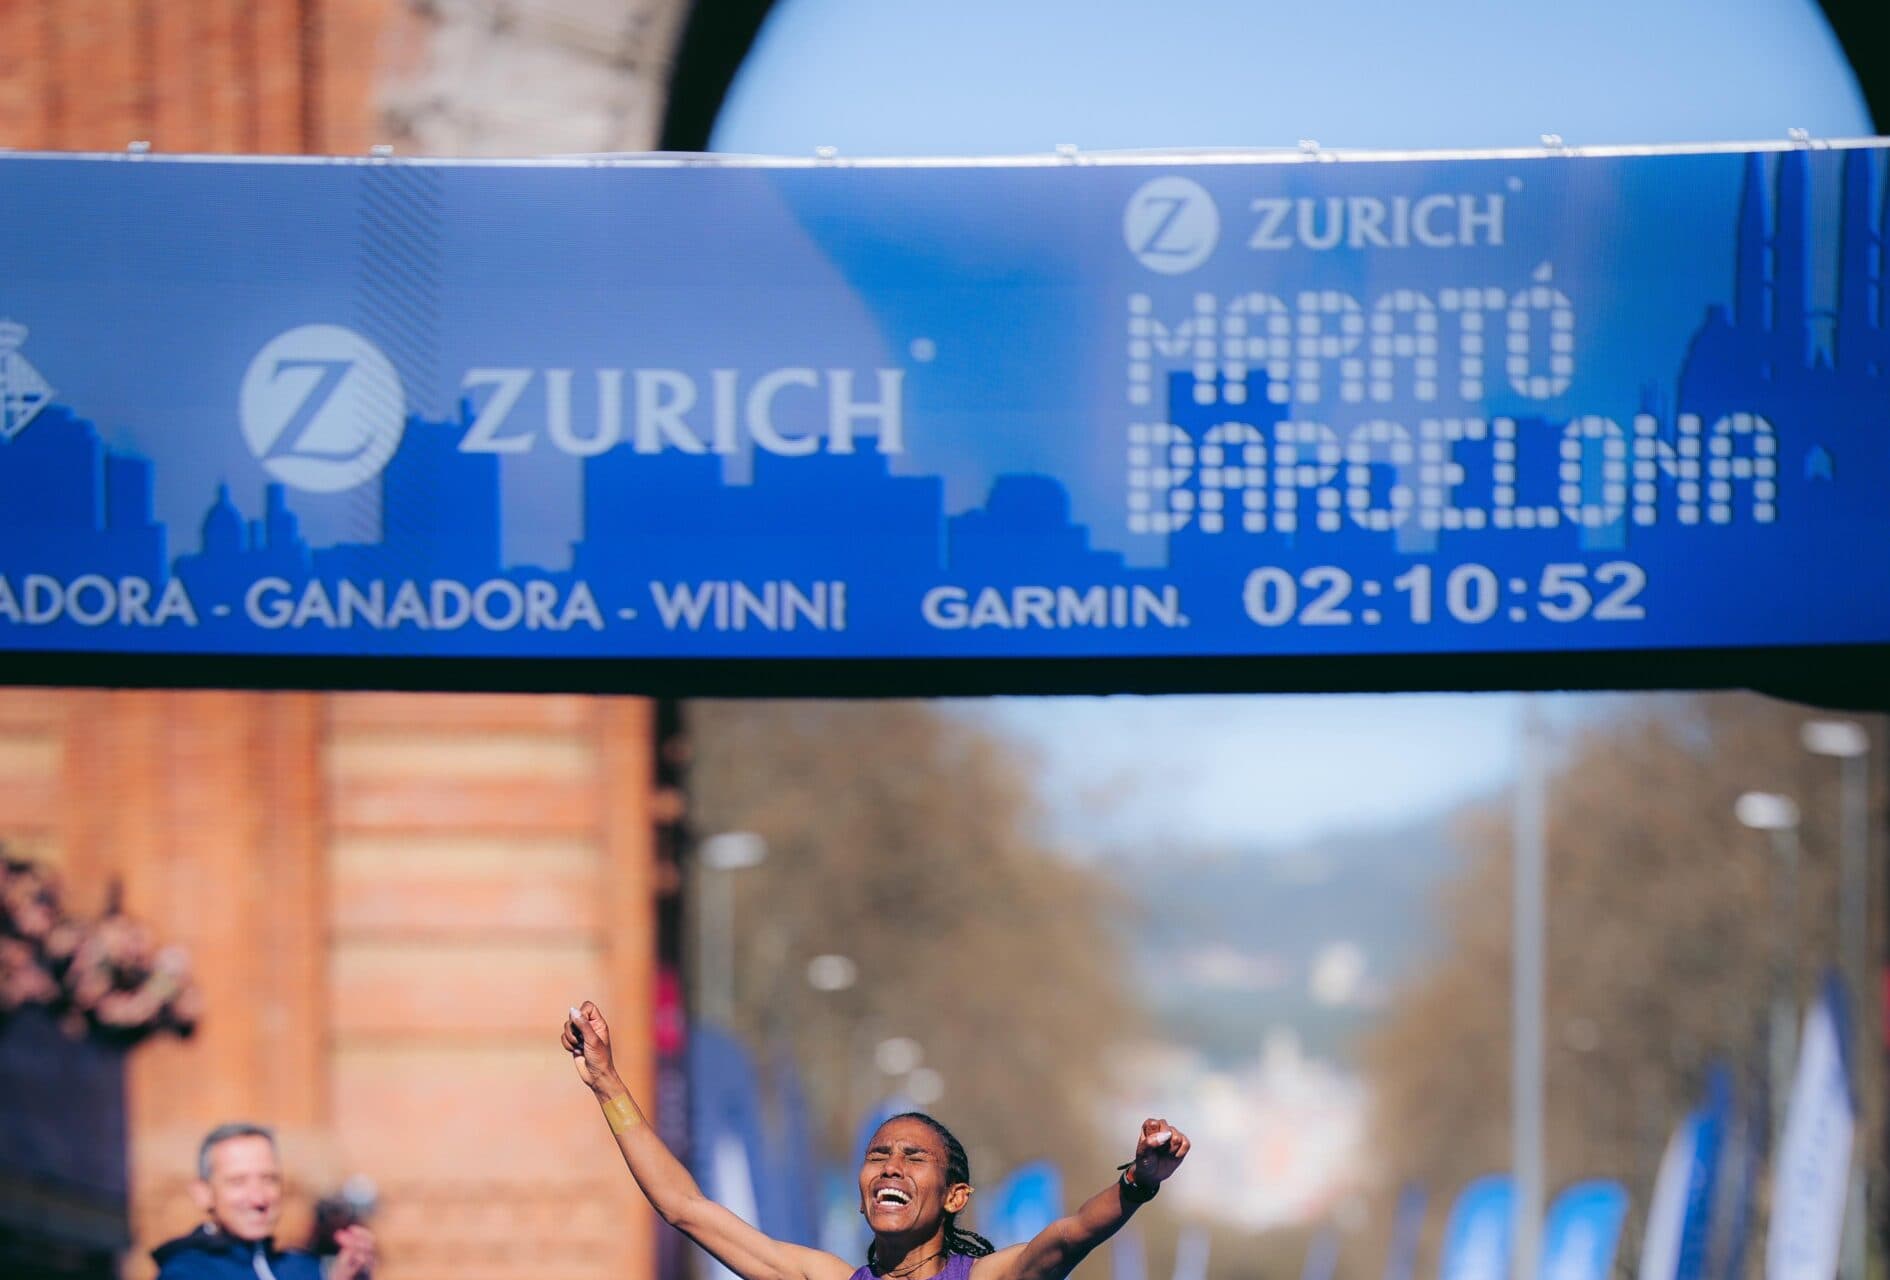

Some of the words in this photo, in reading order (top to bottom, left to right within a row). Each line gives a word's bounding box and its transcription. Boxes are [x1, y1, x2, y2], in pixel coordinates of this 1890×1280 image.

[1248, 194, 1505, 250] ZURICH
[1128, 261, 1574, 406] MARATÓ
[458, 367, 905, 456] ZURICH
[1127, 411, 1778, 534] BARCELONA
[245, 577, 604, 630] GANADORA
[649, 579, 847, 632] WINNI
[1242, 561, 1648, 628] 02:10:52
